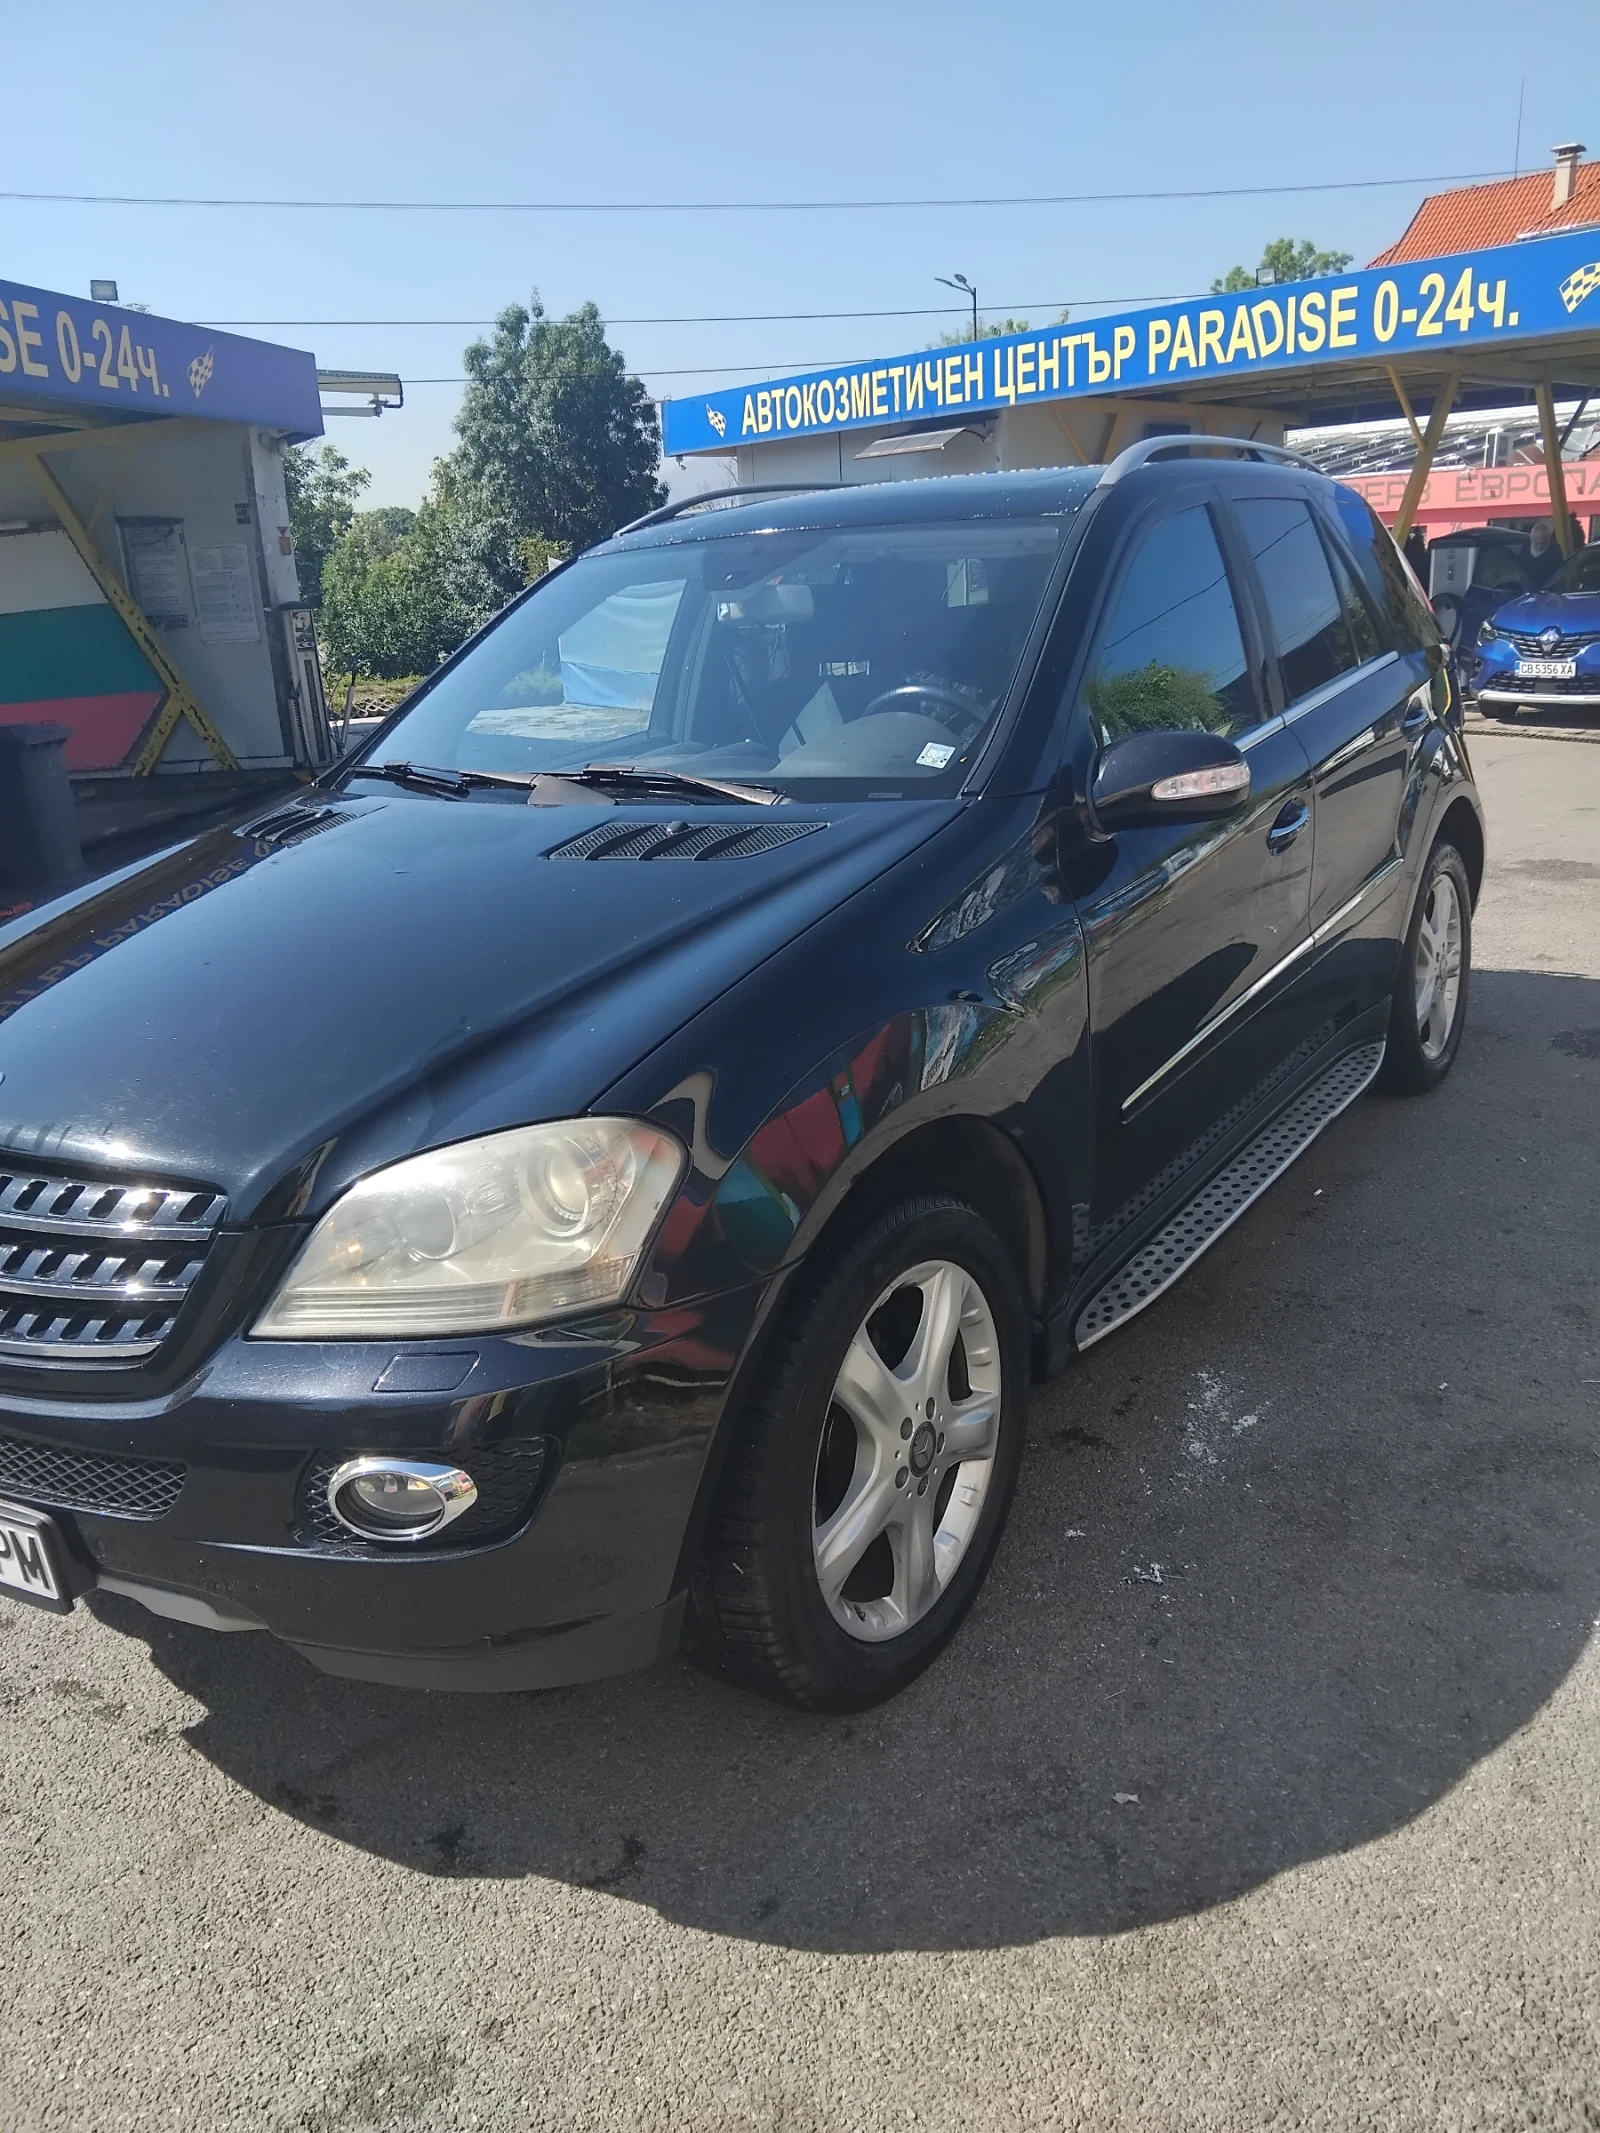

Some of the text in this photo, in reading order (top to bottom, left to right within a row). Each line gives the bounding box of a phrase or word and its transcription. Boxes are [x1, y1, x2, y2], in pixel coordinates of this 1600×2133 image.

[56, 310, 170, 398] 0-24ч.
[740, 267, 1520, 436] АВТОКОЗМЕТИЧЕН ЦЕНТЪР PARADISE 0-24ч.
[1535, 664, 1559, 674] 5356
